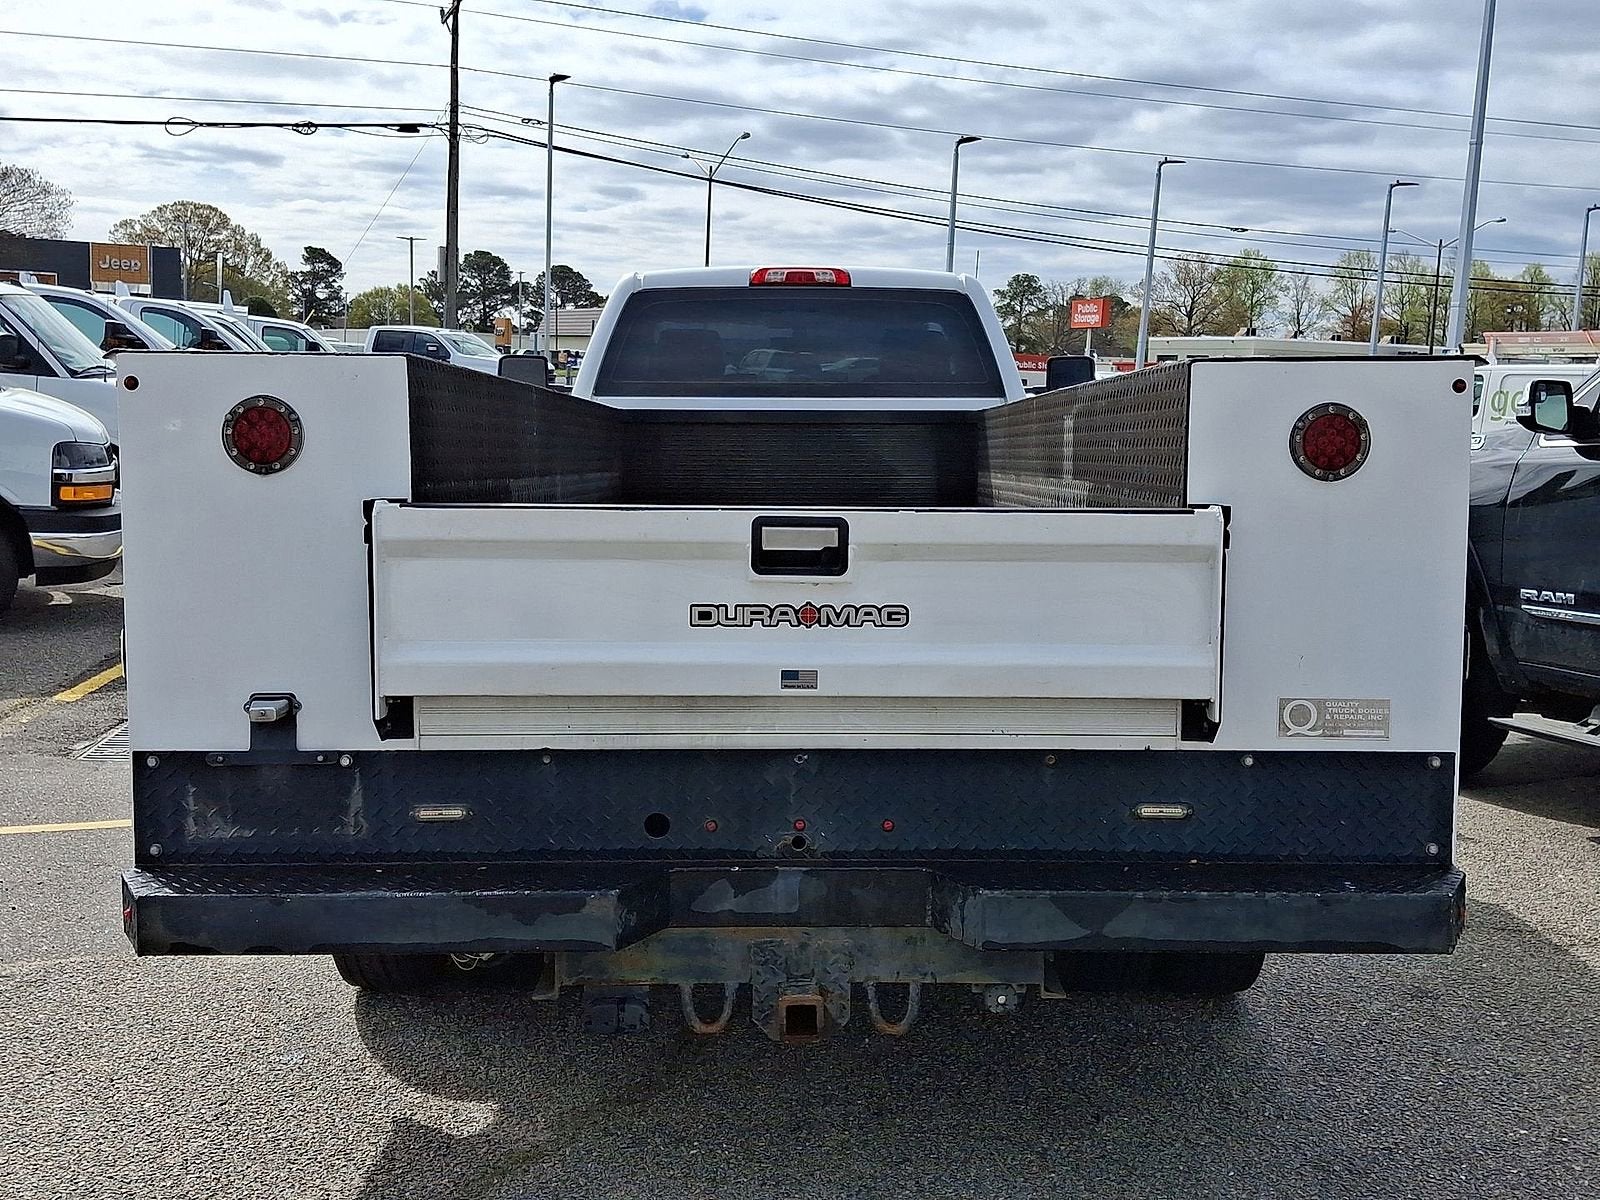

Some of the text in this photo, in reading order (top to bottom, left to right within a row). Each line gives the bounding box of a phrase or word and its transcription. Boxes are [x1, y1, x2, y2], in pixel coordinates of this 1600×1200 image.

[99, 255, 142, 272] Jeep
[1077, 303, 1098, 313] Public
[1074, 313, 1100, 324] Storage
[1520, 588, 1575, 605] RAM
